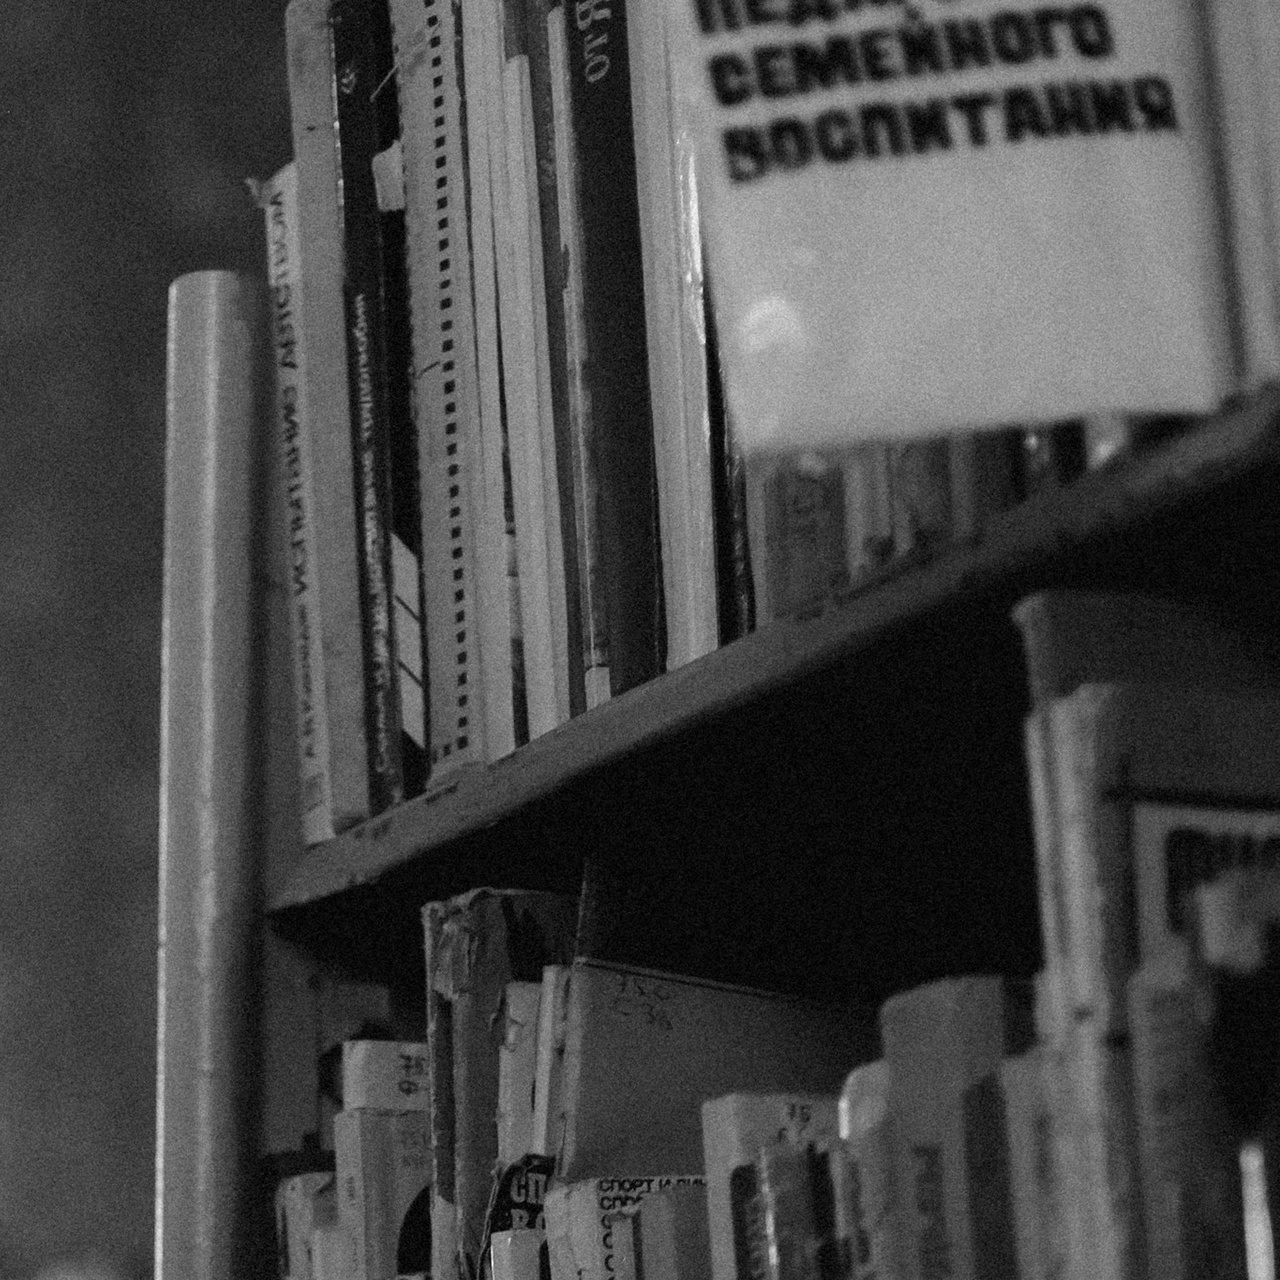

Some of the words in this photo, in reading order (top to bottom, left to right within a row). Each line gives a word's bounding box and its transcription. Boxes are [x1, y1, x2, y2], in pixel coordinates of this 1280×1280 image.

[709, 4, 1114, 107] СЕМЕЙНОГО
[723, 76, 1180, 183] ВОСПИТАНИЯ
[600, 1178, 654, 1194] СПОРТ
